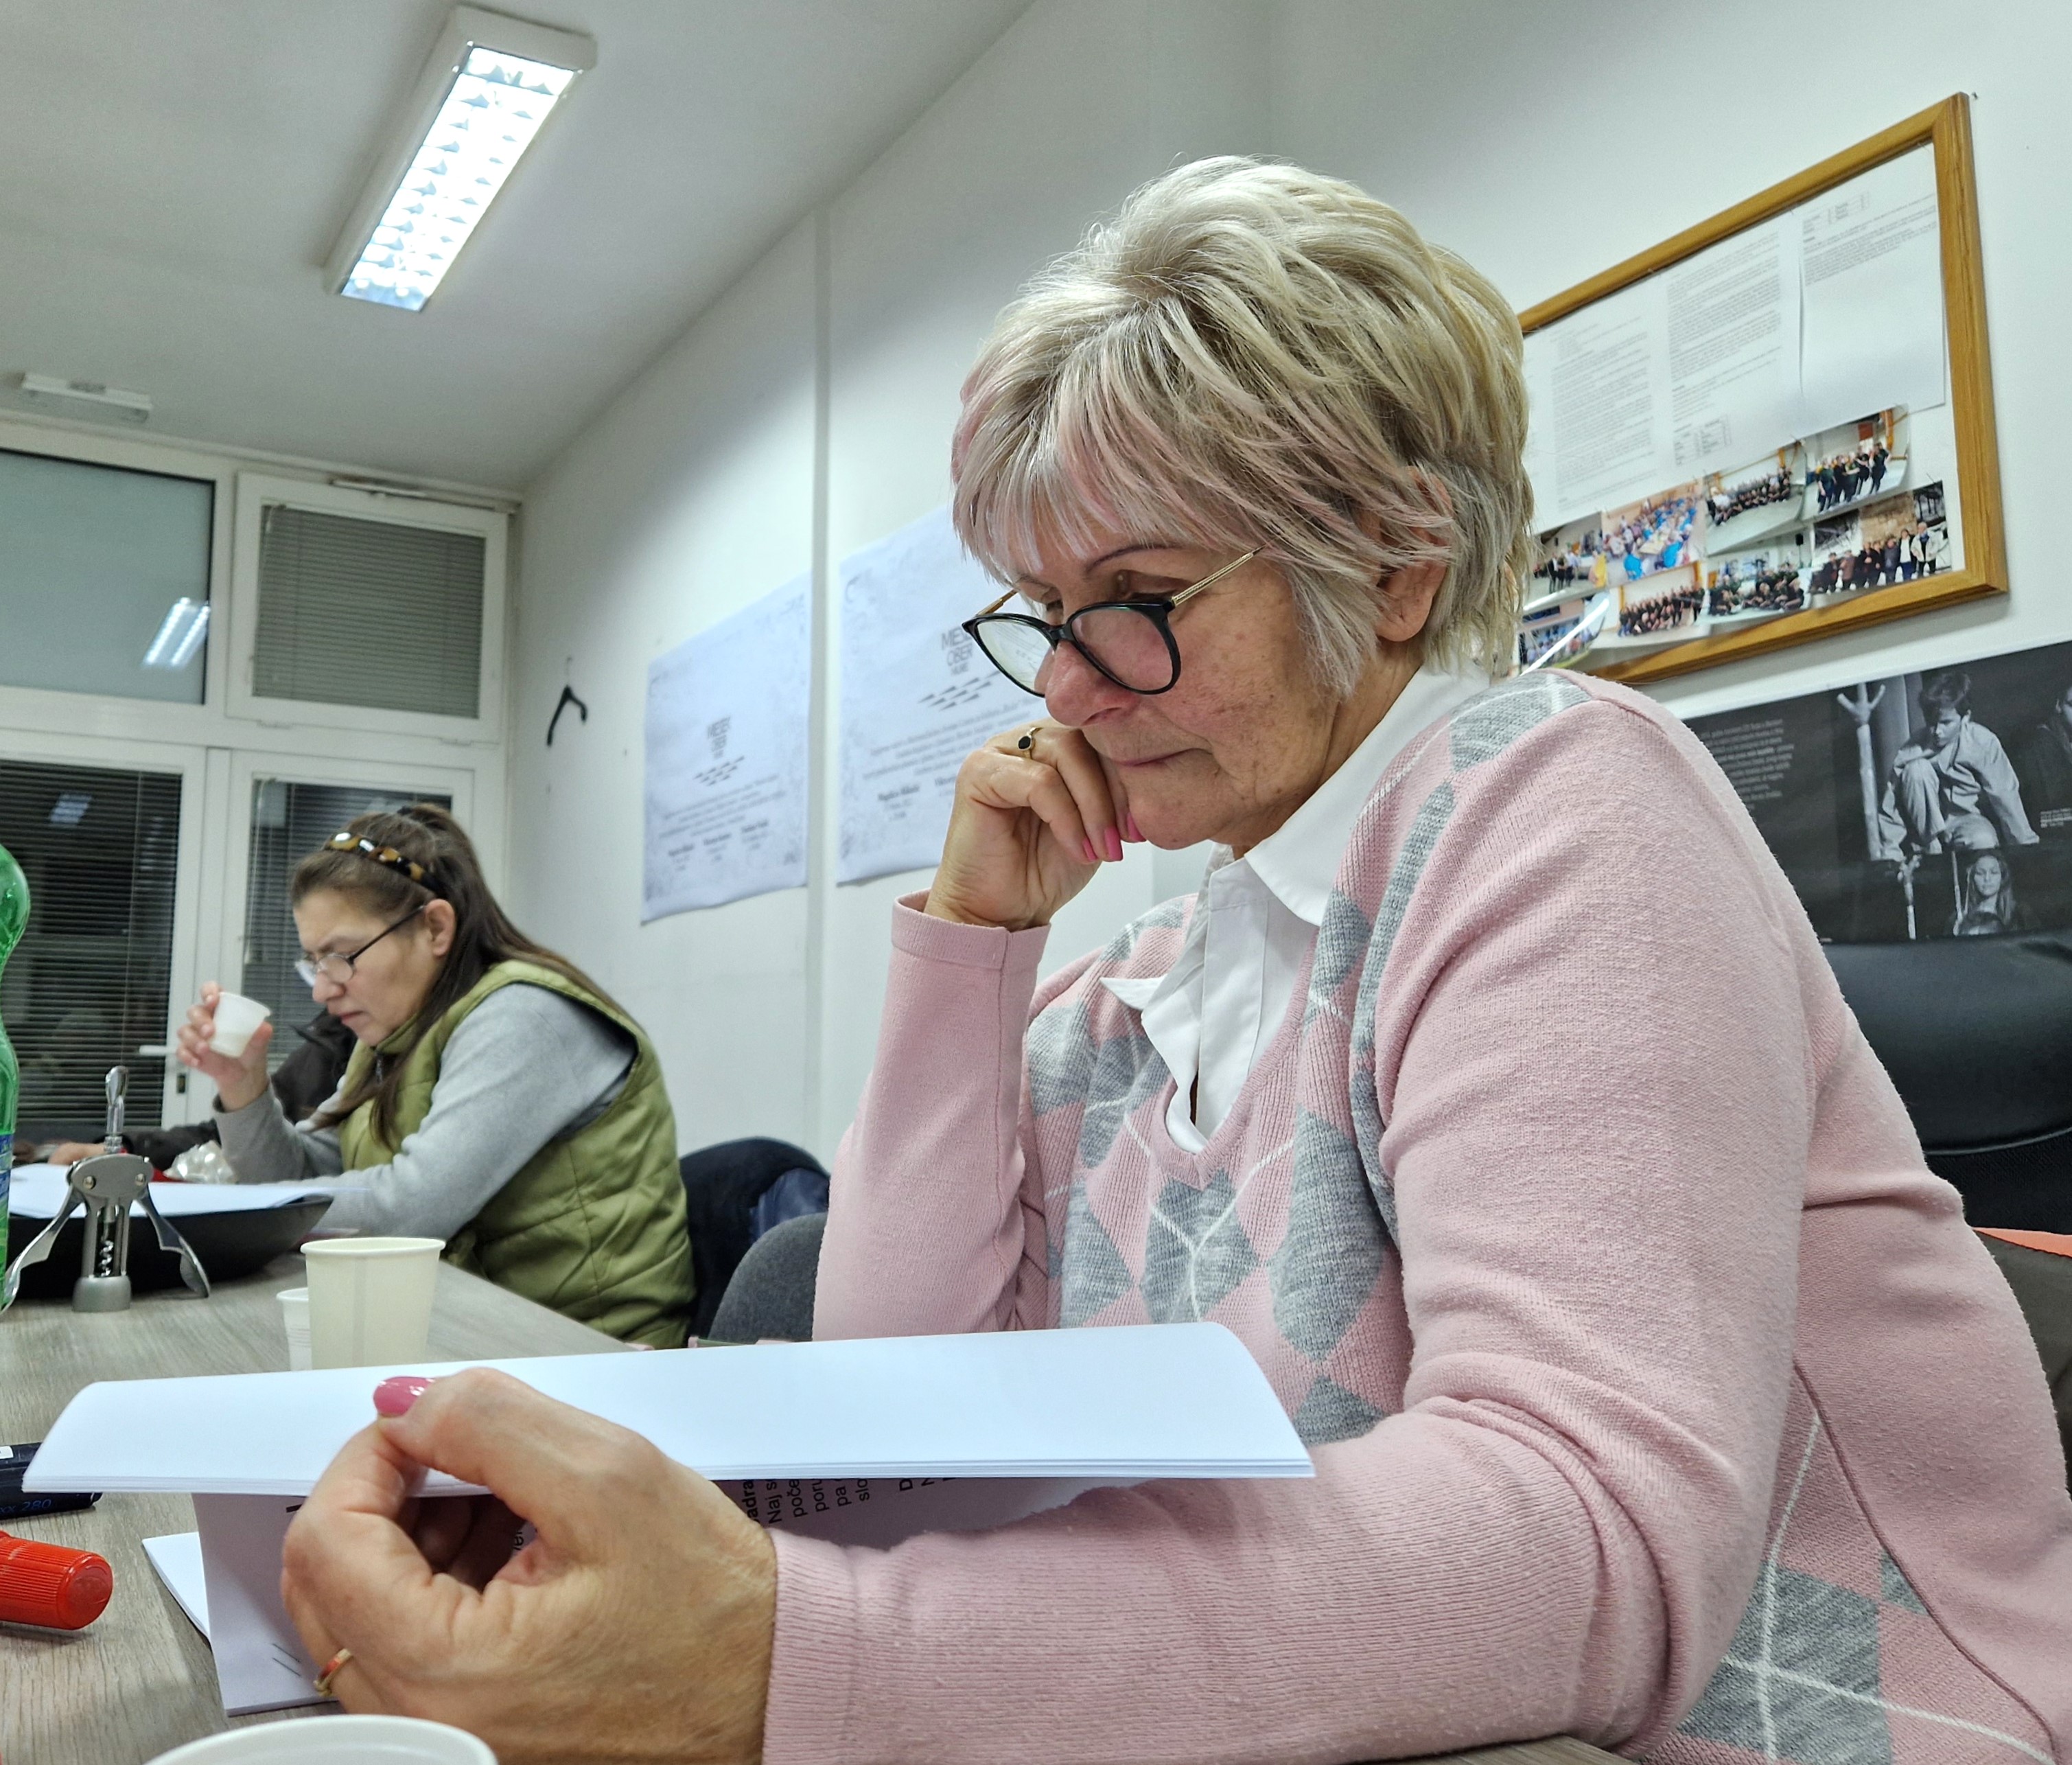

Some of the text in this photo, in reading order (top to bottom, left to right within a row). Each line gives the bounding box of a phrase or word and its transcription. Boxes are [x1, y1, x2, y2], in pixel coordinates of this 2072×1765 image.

[22, 1499, 51, 1511] 280
[835, 1486, 852, 1506] pa
[765, 1494, 782, 1523] Naj
